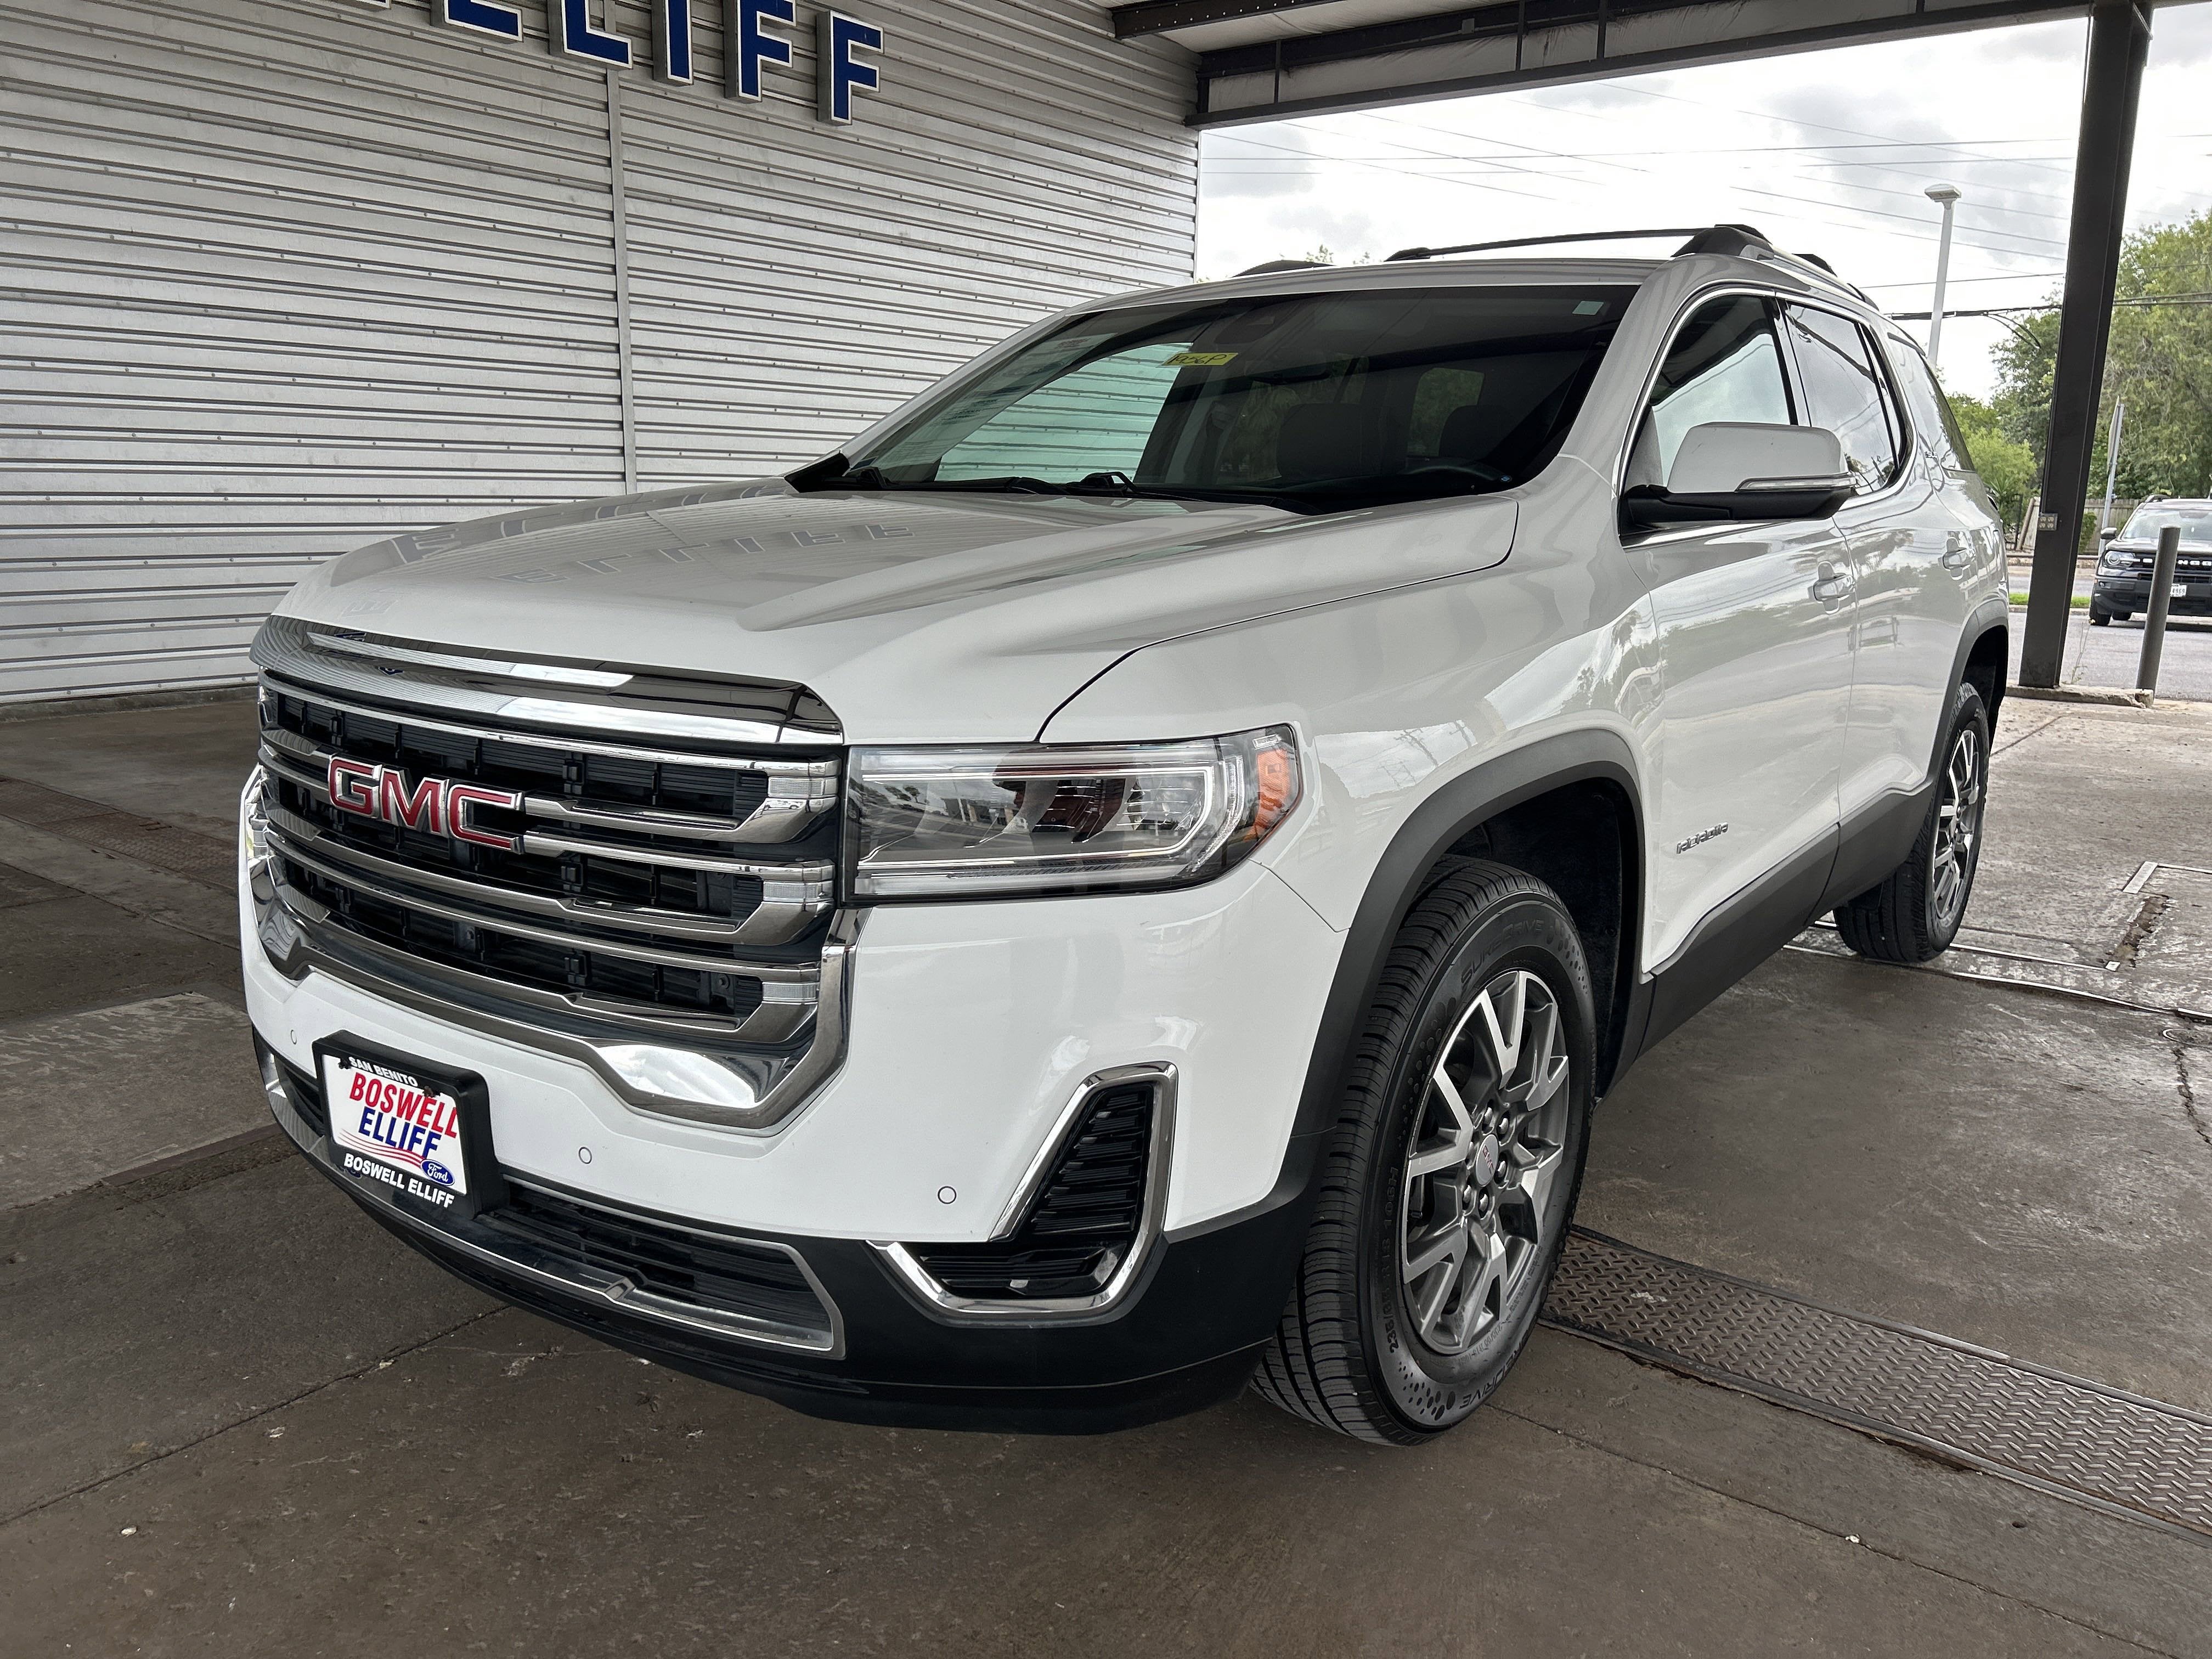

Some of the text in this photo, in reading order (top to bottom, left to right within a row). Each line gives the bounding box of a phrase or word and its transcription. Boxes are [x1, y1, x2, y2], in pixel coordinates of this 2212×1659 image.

[328, 756, 524, 855] GMC
[348, 1057, 419, 1087] SAN BENITO
[349, 1072, 458, 1139] BOSWELL
[358, 1105, 442, 1159] ELLIFF
[343, 1153, 455, 1209] BOSWELL ELLIFF
[427, 1163, 449, 1183] Ford
